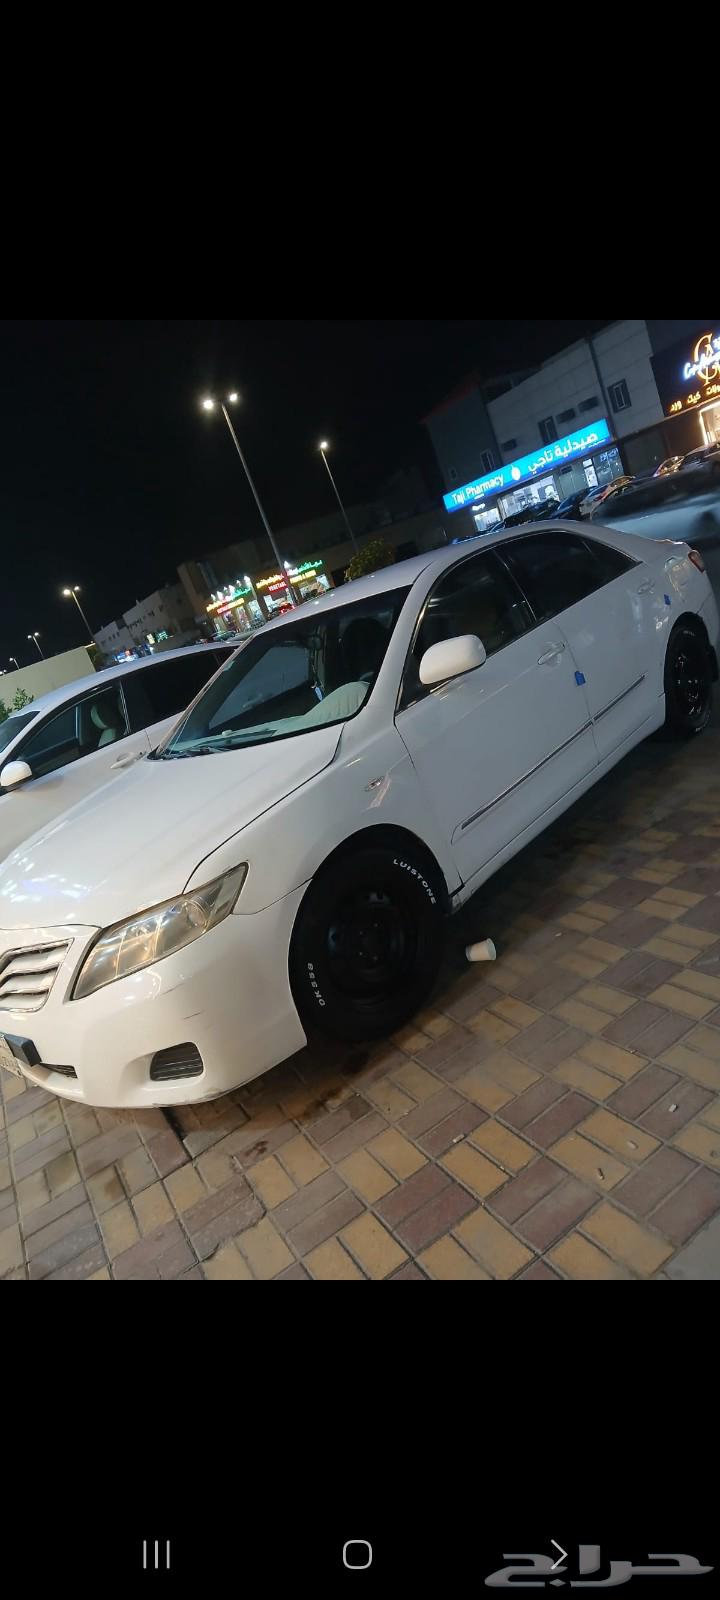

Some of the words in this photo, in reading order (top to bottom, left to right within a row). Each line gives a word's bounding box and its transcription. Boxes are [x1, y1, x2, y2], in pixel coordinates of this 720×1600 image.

[554, 432, 599, 458] صيدلية
[527, 450, 554, 475] تاجي
[451, 491, 465, 505] Taji
[466, 473, 505, 499] Pharmacy
[393, 858, 437, 904] LUISTONE
